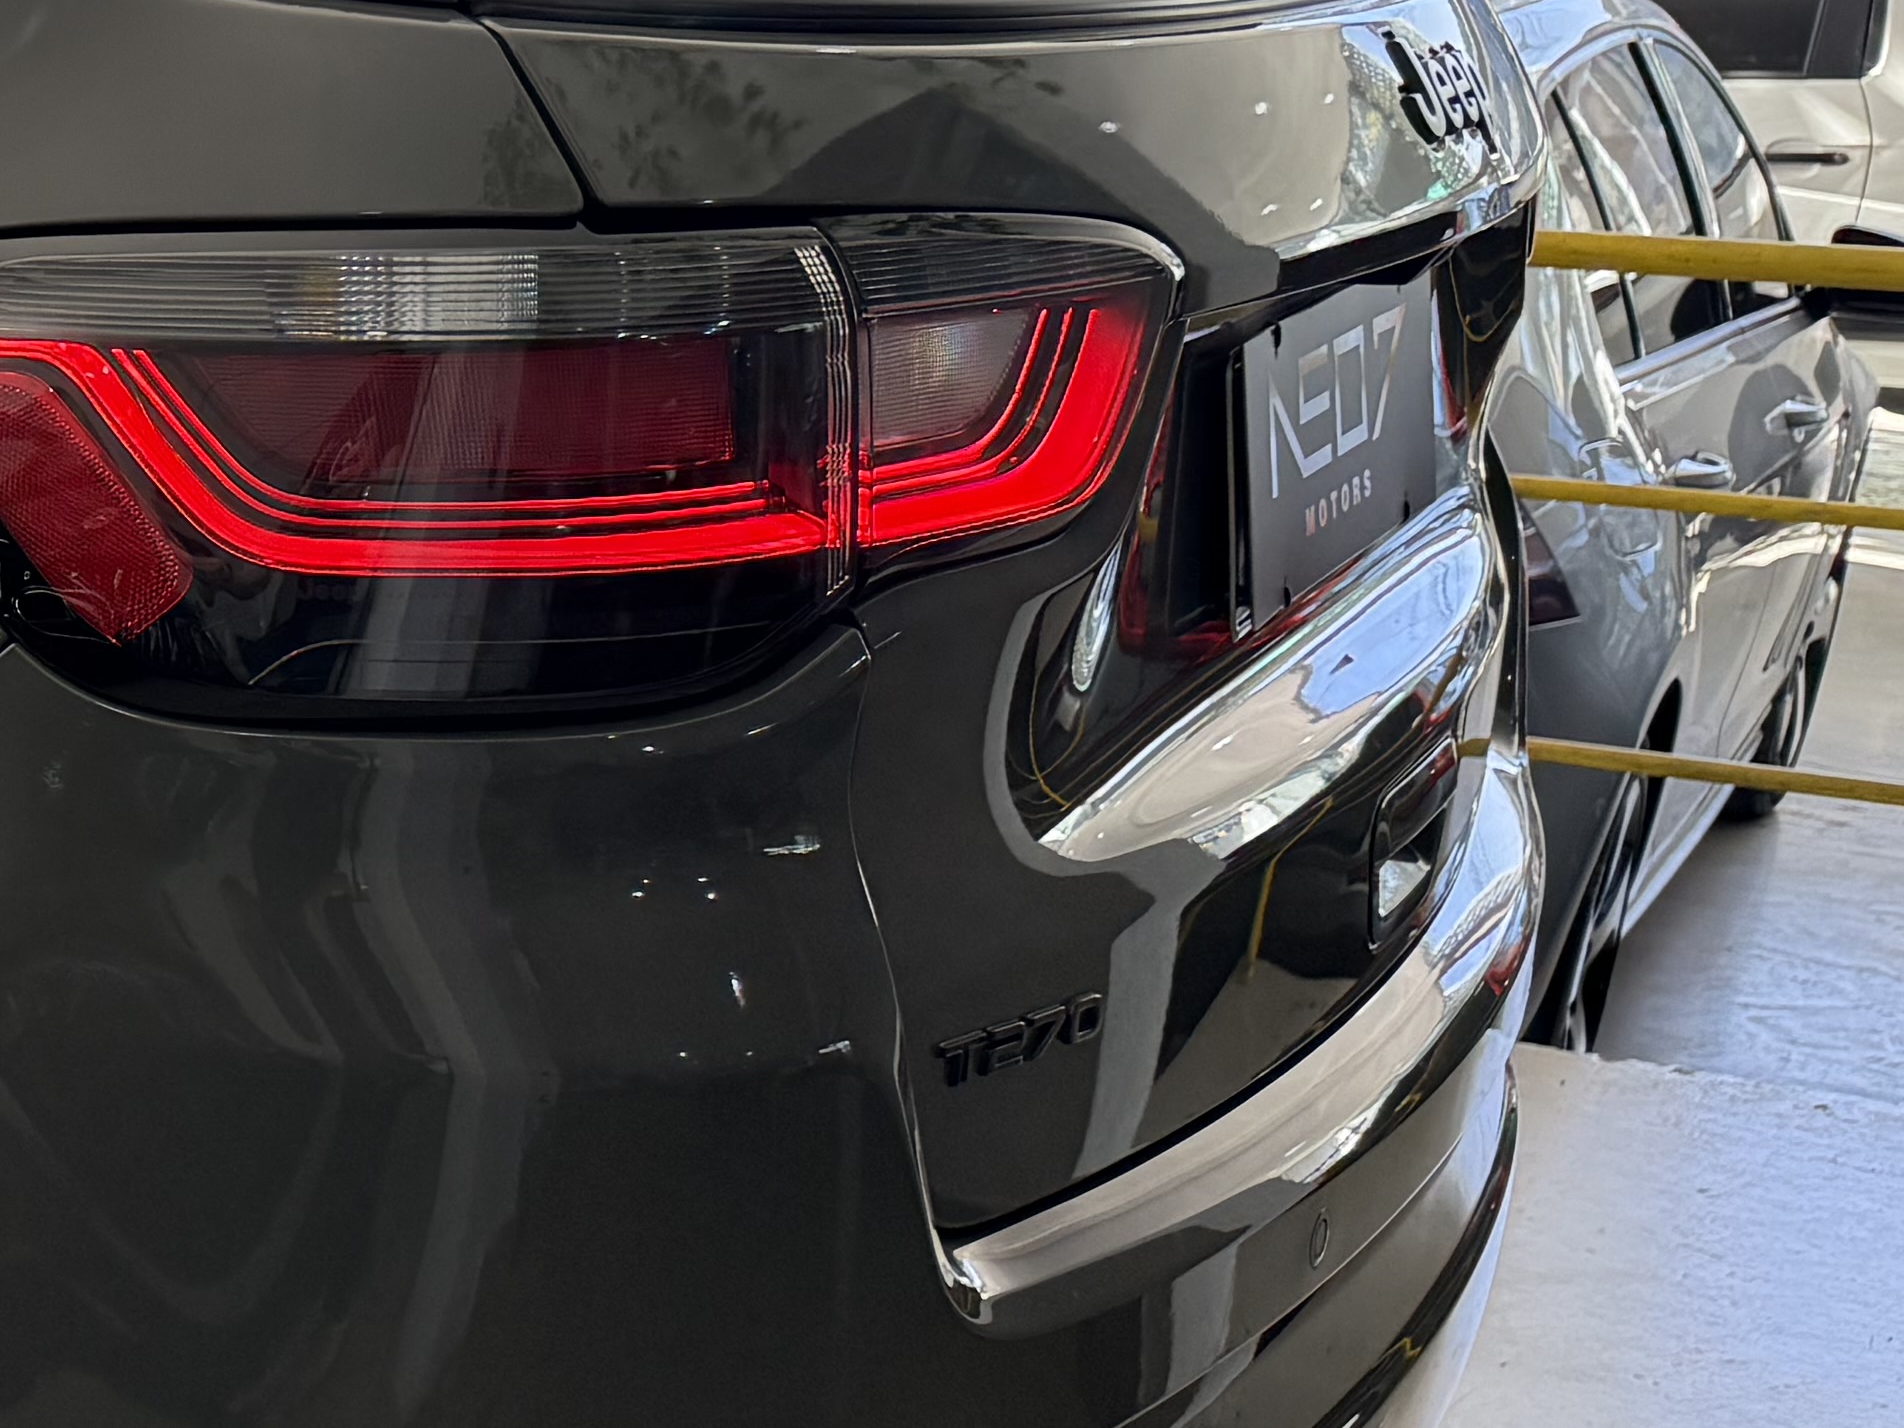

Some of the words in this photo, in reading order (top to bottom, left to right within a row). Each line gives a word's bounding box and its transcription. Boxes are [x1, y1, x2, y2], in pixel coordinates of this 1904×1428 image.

[1382, 28, 1499, 159] Jeep
[1304, 468, 1372, 537] MOTORS
[935, 992, 1102, 1087] T270
